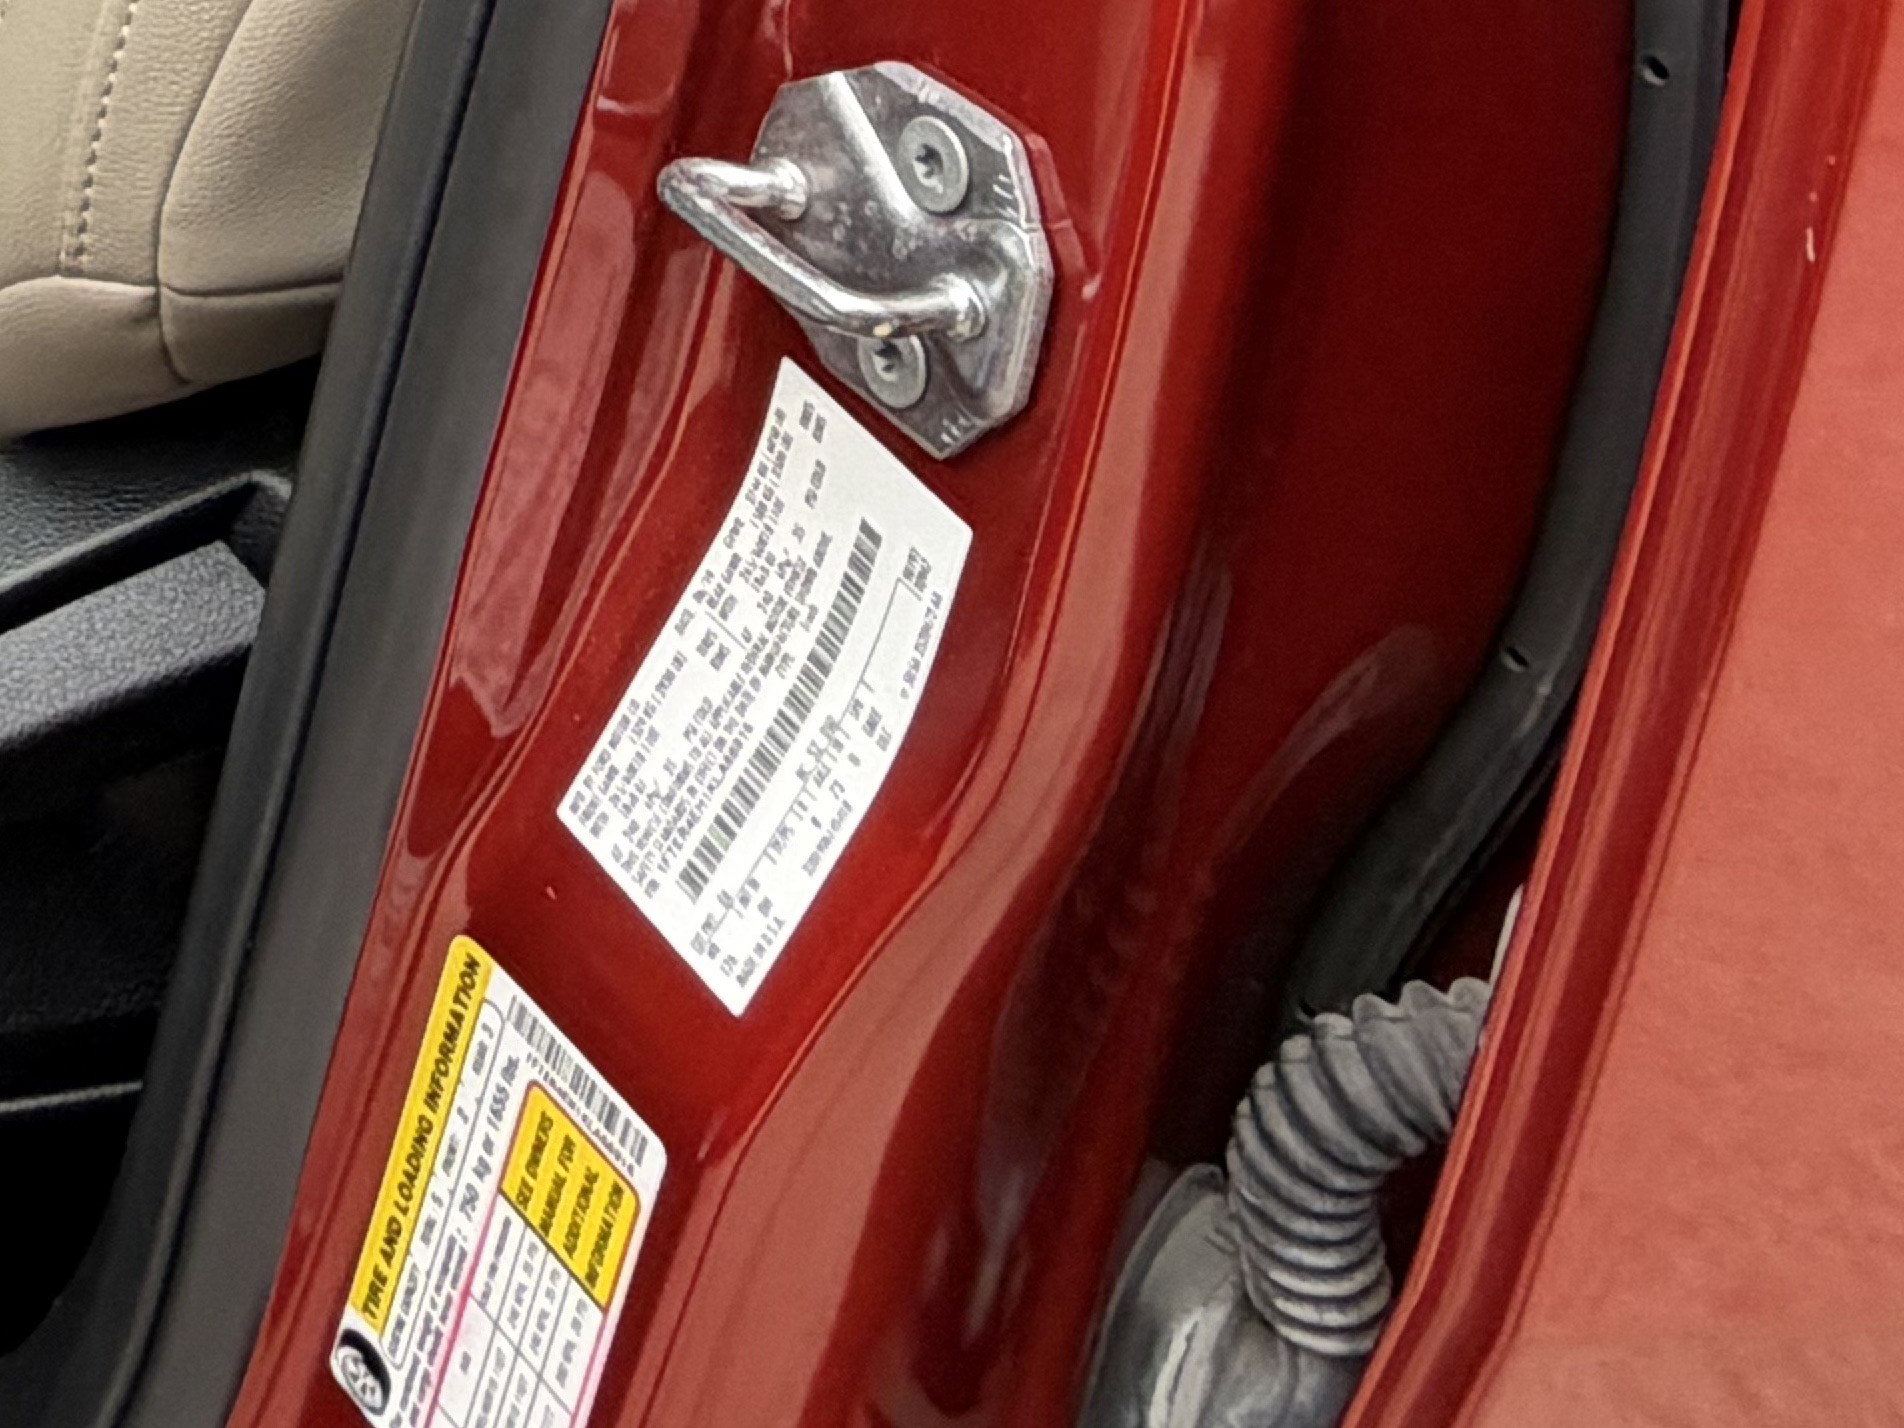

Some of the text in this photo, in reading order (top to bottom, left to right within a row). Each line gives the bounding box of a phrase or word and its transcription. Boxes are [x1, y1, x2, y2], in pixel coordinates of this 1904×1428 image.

[363, 956, 479, 1317] TIRE AND LOADING INFORMATION
